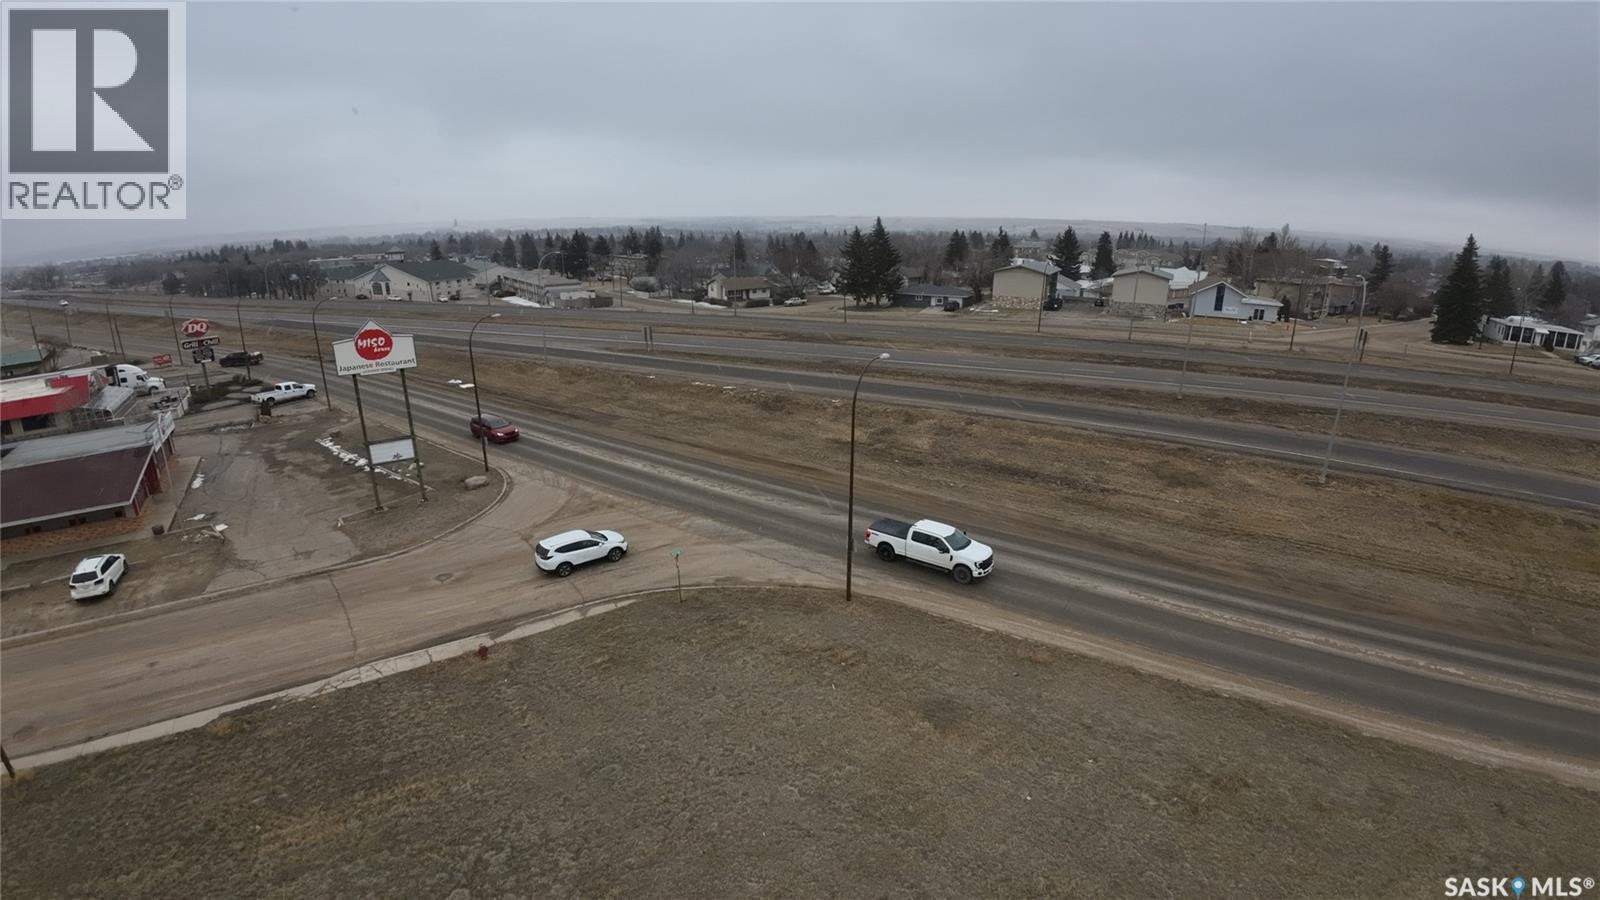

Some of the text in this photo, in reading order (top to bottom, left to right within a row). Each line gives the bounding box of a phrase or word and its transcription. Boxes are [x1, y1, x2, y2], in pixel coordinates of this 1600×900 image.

[188, 322, 207, 333] DQ
[357, 337, 385, 349] MISO
[339, 363, 373, 372] Japanese
[375, 359, 415, 368] Restaurant
